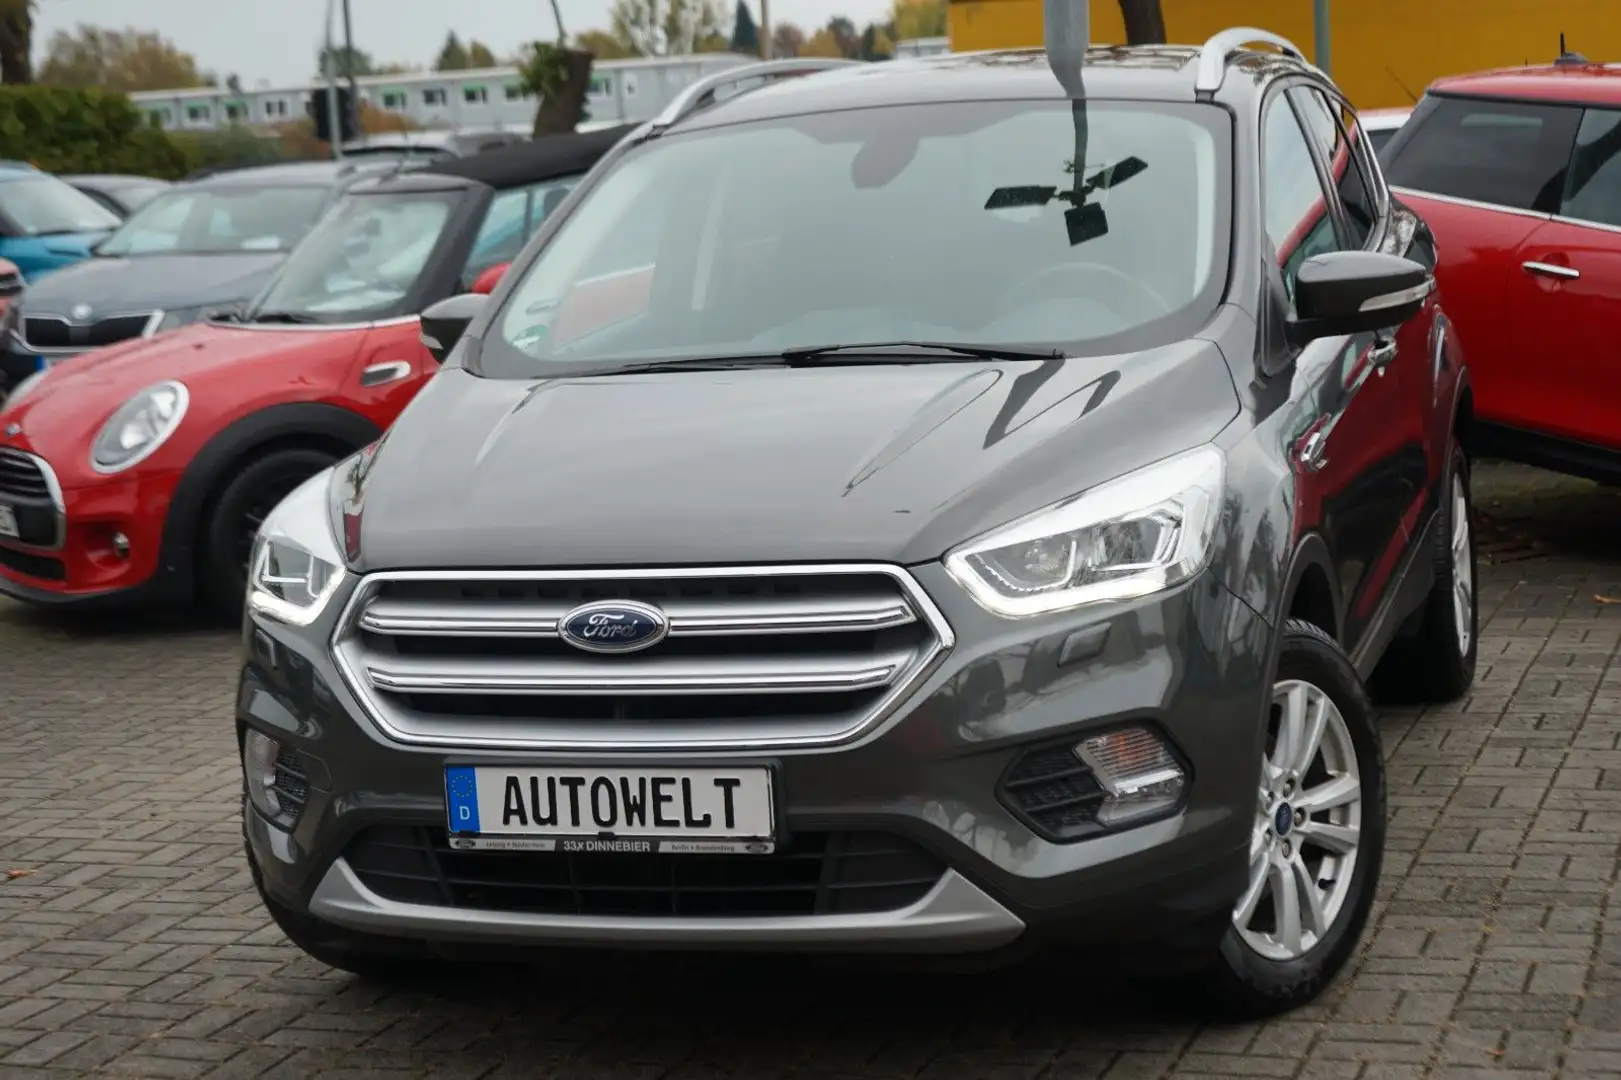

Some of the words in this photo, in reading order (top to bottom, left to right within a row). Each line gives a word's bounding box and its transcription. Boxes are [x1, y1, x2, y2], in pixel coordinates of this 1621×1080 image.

[583, 613, 638, 637] Ford
[502, 776, 741, 828] AUTOWELT
[459, 805, 471, 820] D
[586, 840, 651, 852] DINNEBIER
